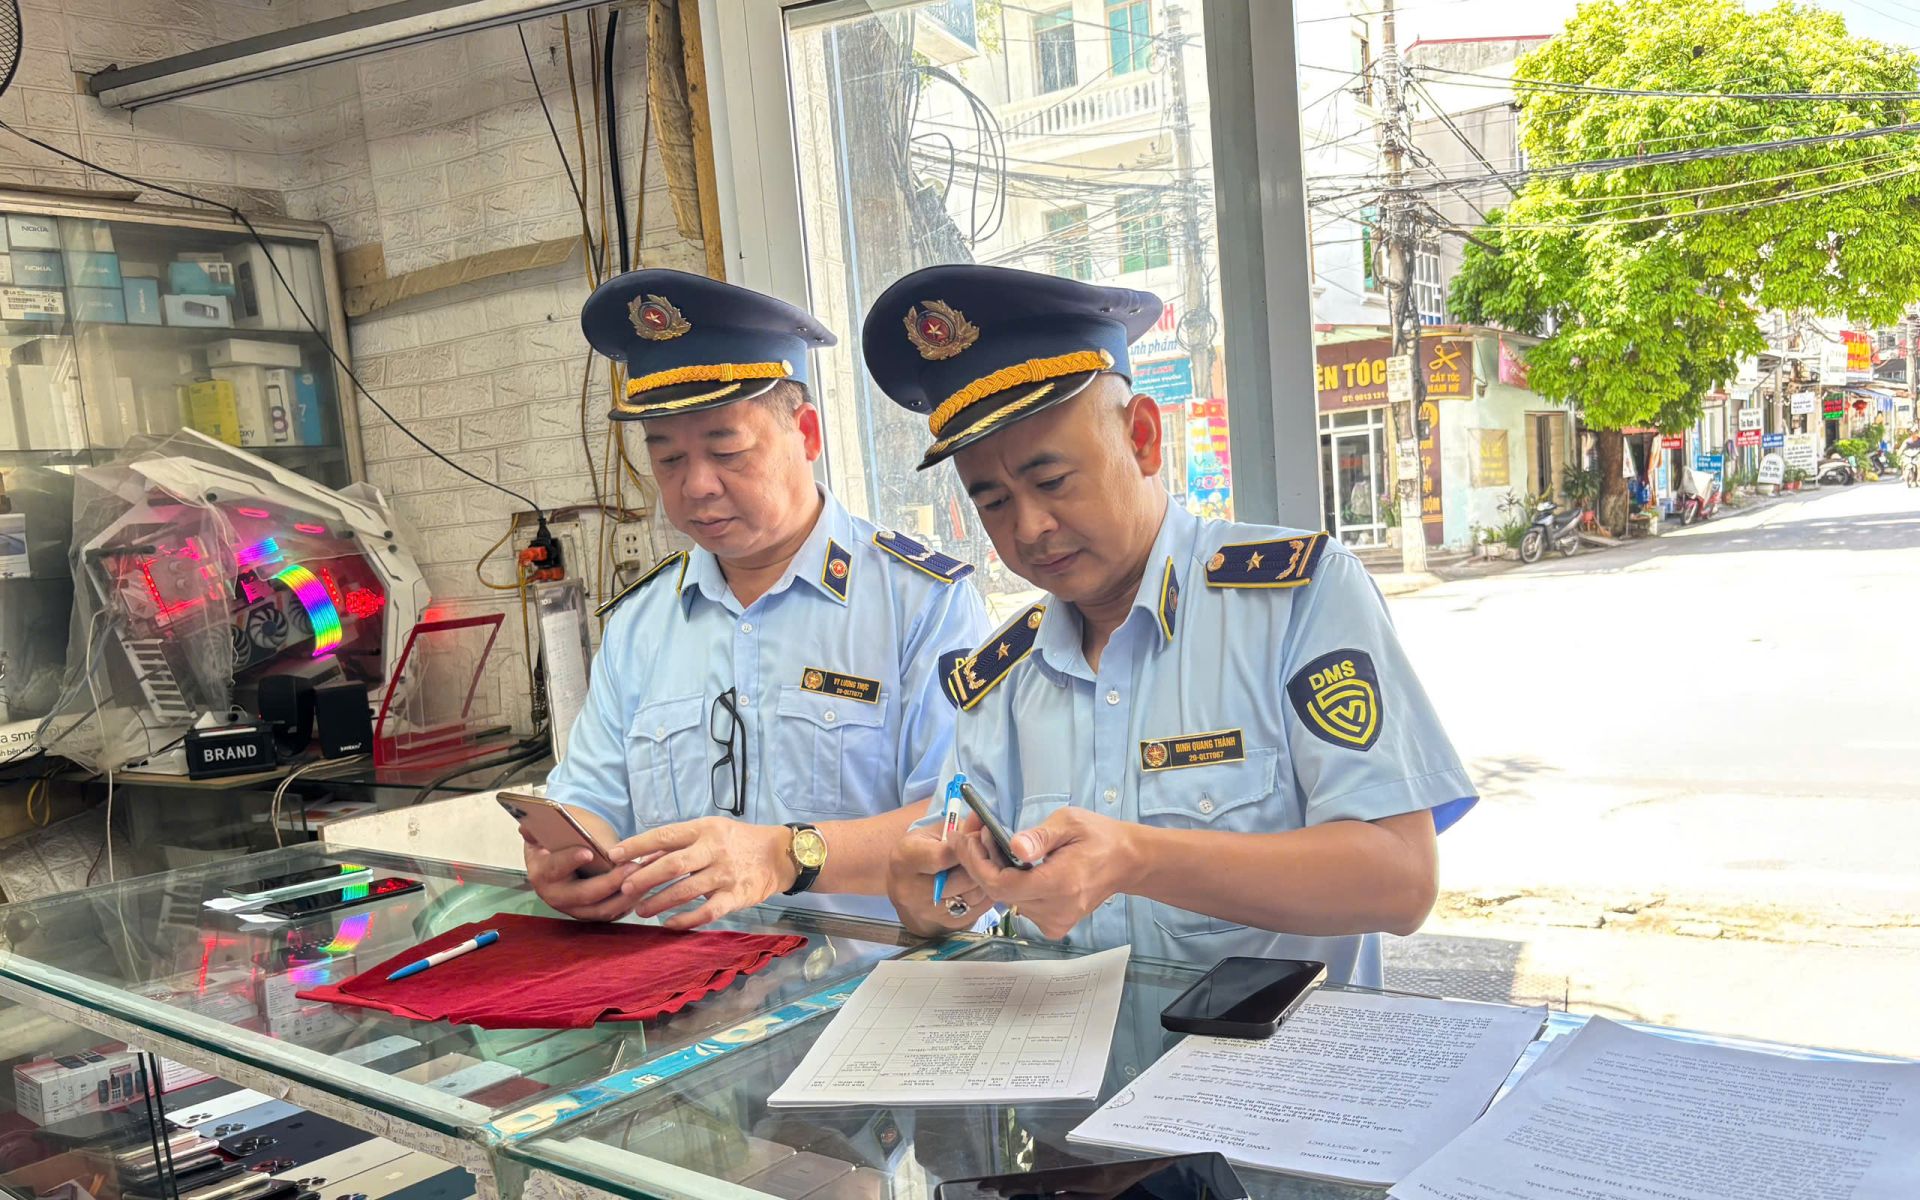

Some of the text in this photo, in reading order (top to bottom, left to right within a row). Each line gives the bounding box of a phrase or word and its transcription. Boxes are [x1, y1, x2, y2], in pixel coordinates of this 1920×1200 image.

[21, 225, 49, 233] NOKIA
[1342, 357, 1387, 388] TÓC
[1308, 659, 1357, 691] DMS
[203, 744, 258, 763] BRAND
